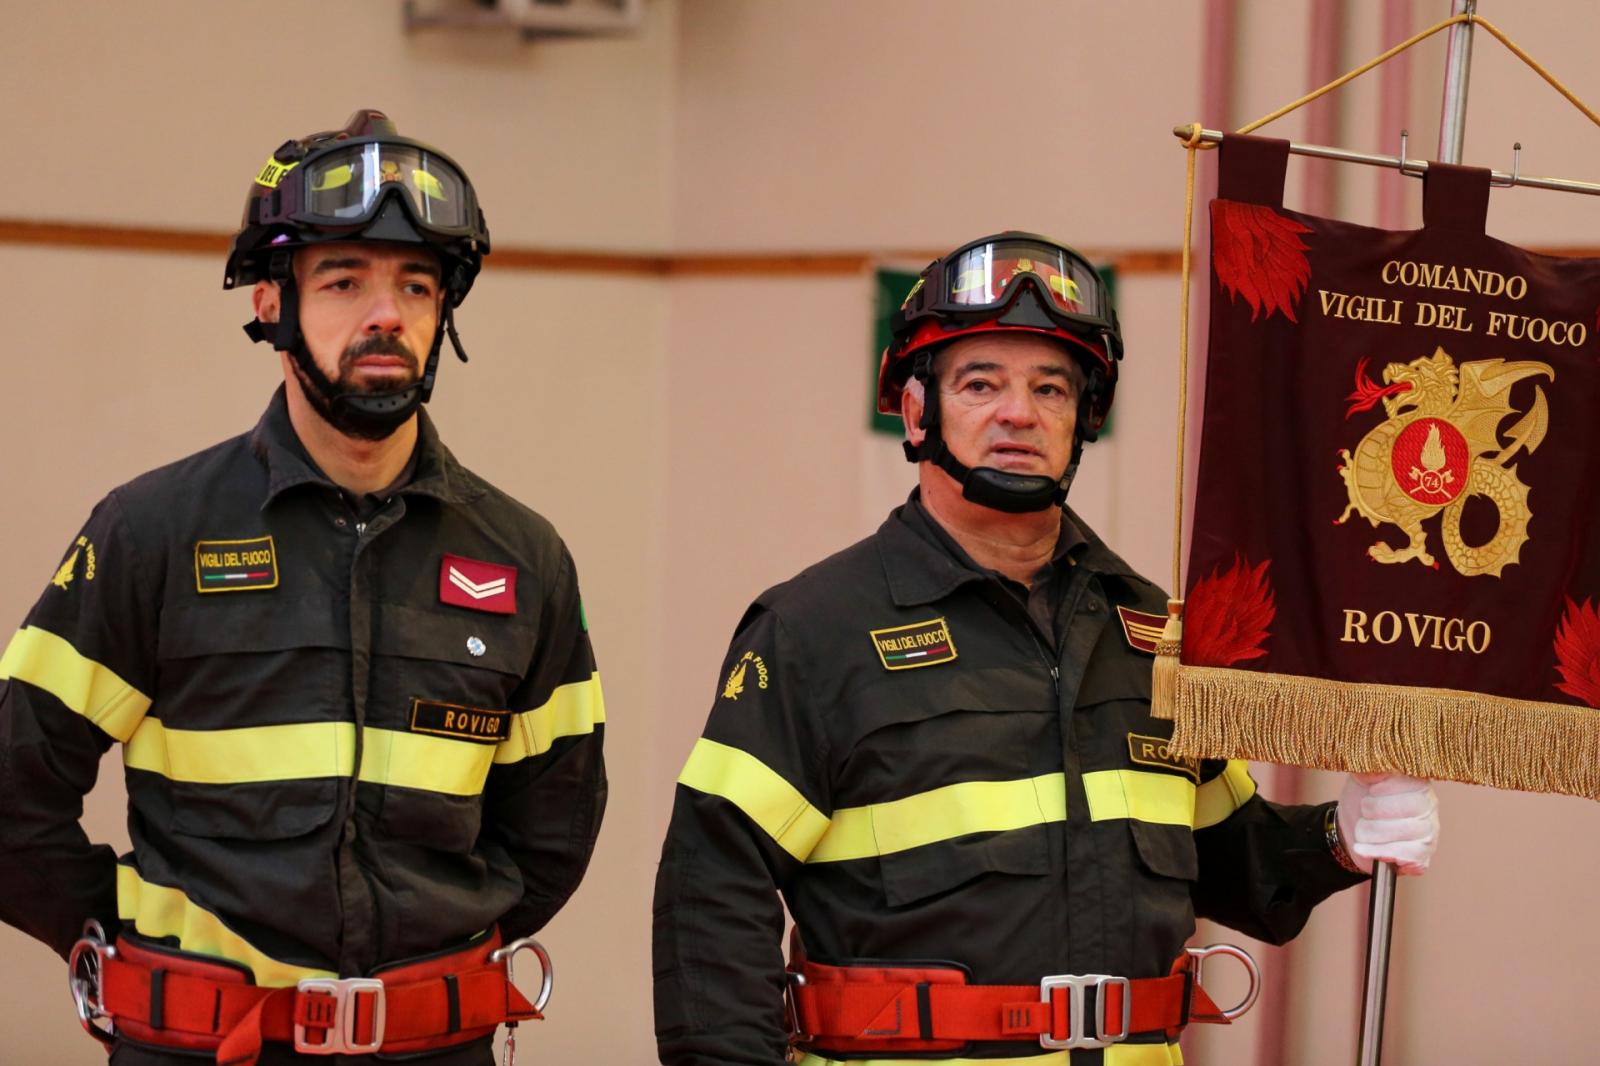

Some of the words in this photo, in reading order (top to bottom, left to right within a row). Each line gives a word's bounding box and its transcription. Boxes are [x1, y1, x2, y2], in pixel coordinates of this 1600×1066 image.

[1381, 260, 1528, 300] COMANDO
[1318, 289, 1404, 325] VIGILI
[1414, 302, 1473, 332] DEL
[1486, 311, 1587, 347] FUOCO
[1424, 476, 1440, 488] 74
[200, 553, 223, 567] VIGILI
[224, 552, 241, 566] DEL
[241, 550, 270, 565] FUOCO
[879, 638, 902, 652] VIGILI
[901, 636, 918, 650] DEL
[917, 629, 945, 646] FUOCO
[1340, 609, 1491, 654] ROVIGO
[445, 711, 500, 733] ROVIGO
